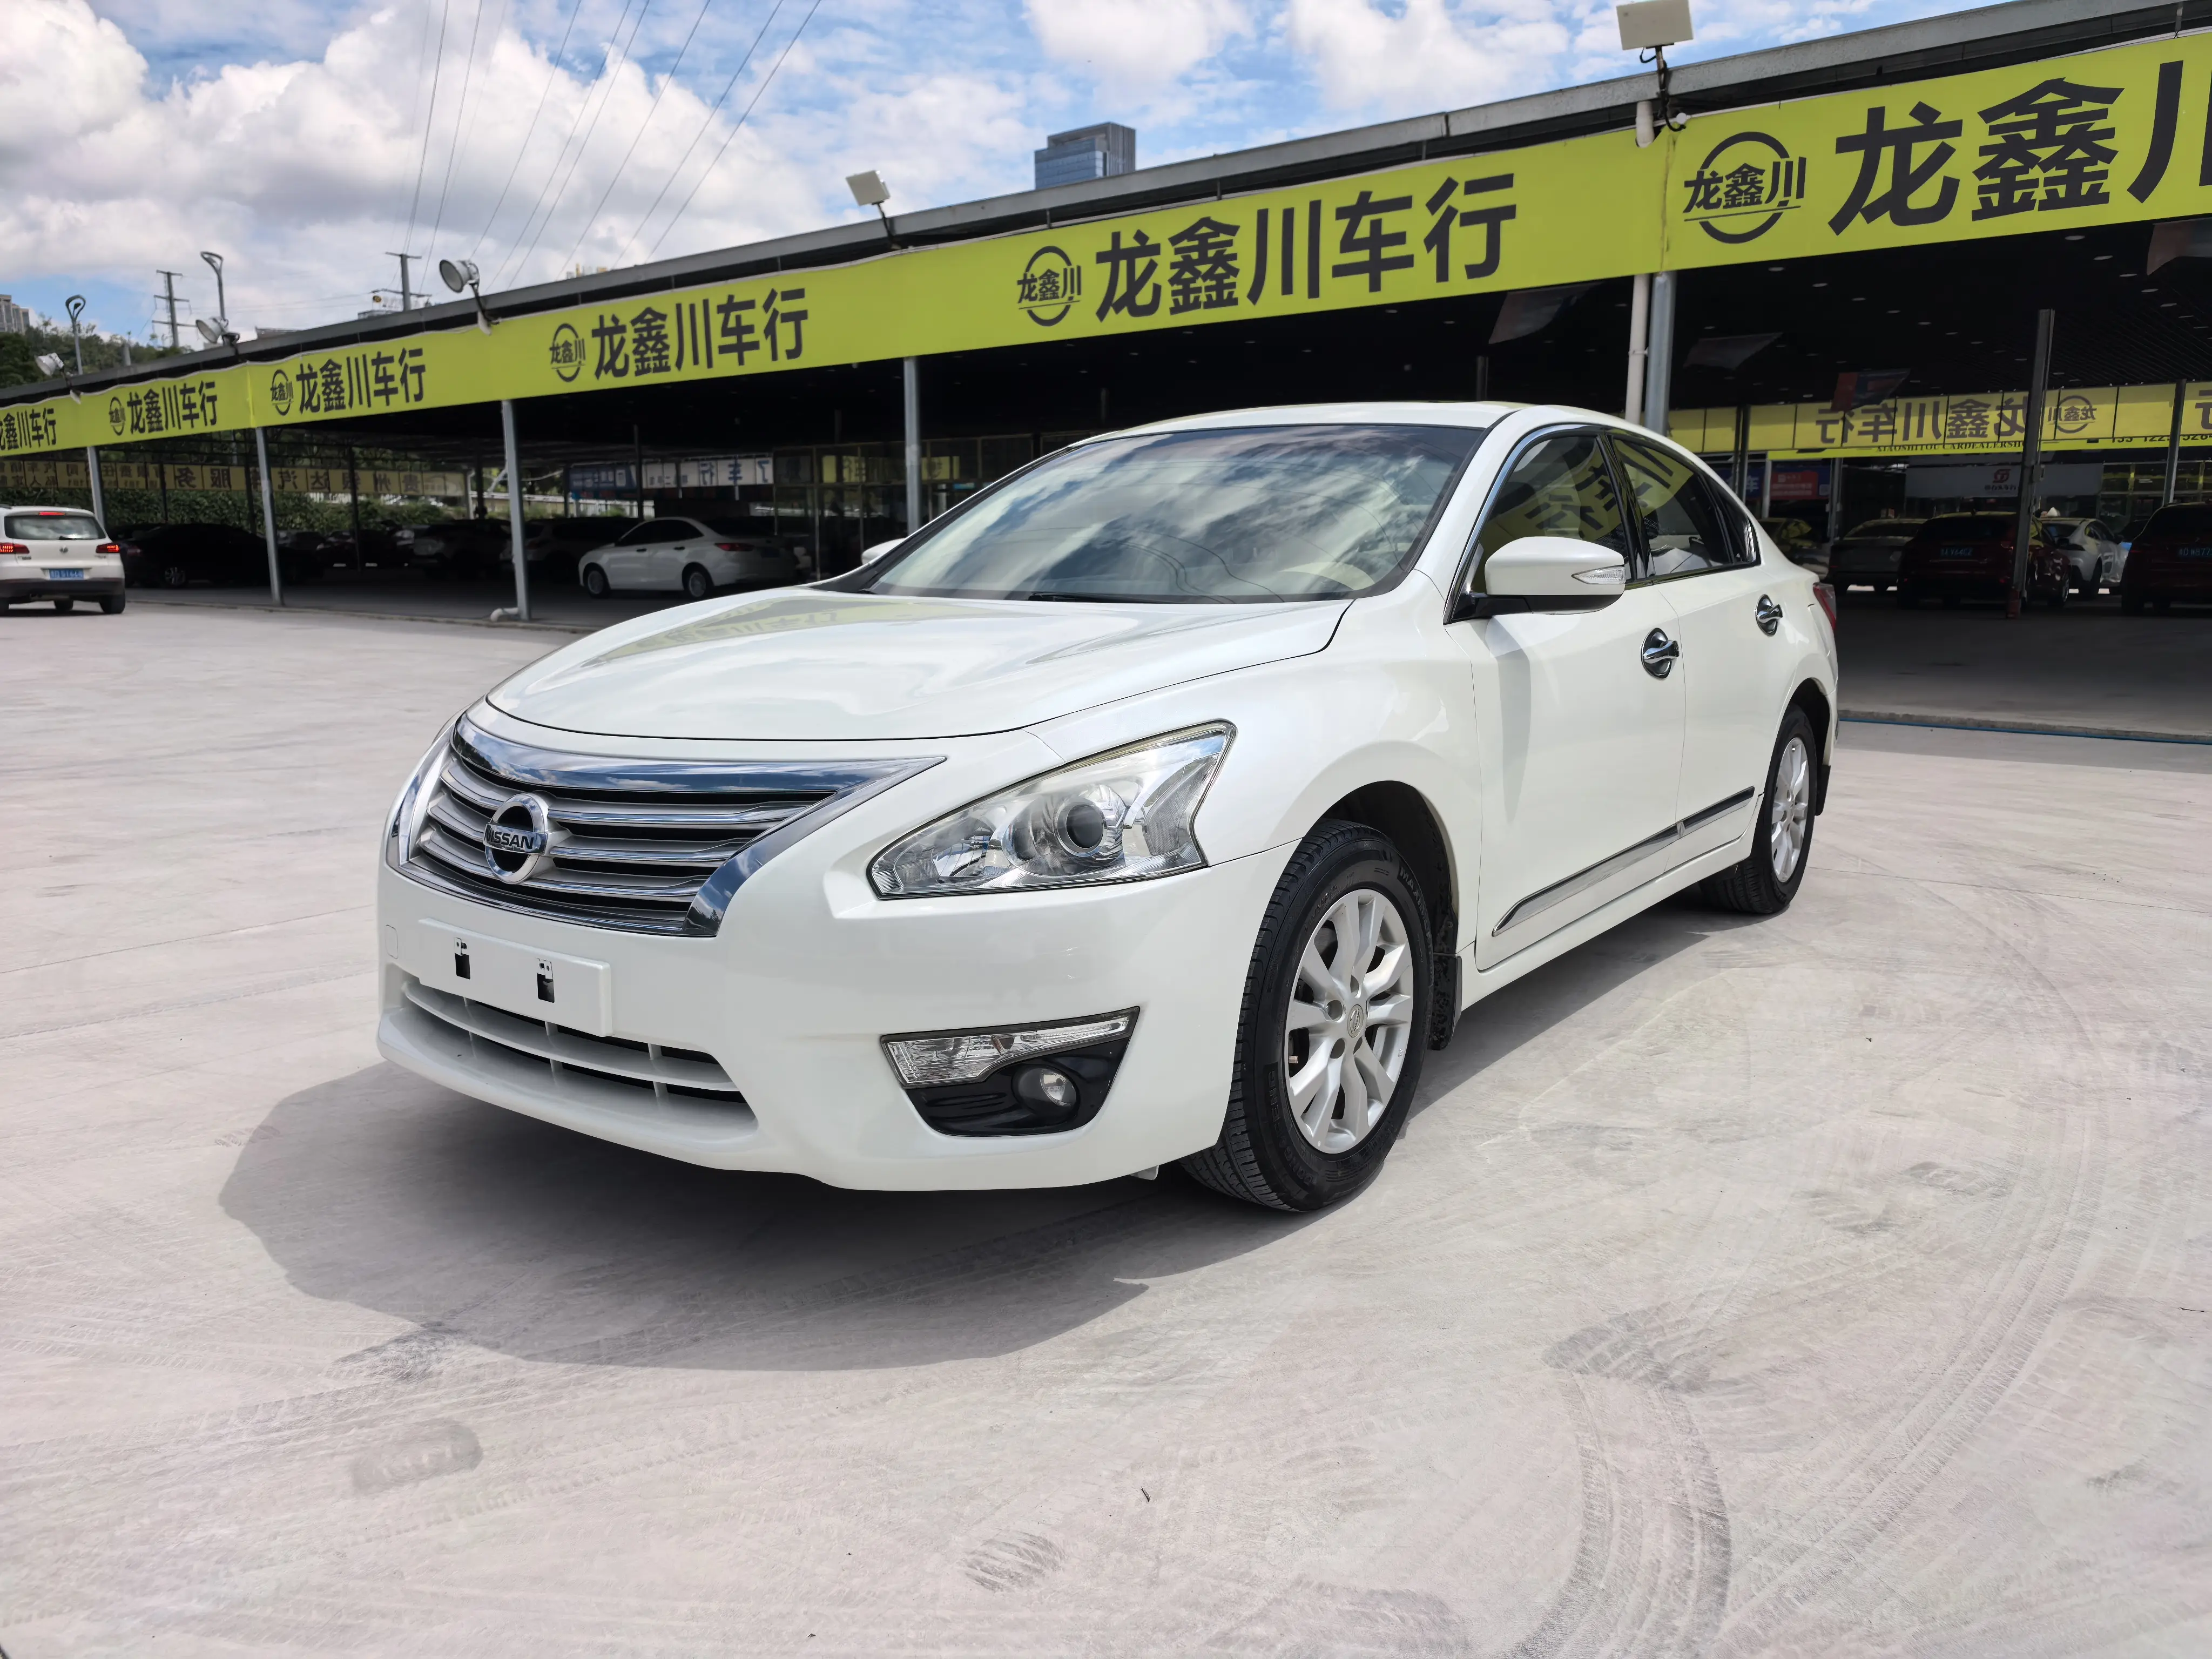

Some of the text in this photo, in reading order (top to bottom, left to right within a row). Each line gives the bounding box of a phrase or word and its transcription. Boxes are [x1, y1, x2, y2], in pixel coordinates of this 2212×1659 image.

[1683, 156, 1806, 213] 龙鑫川
[1017, 173, 1516, 322] 龙鑫川 龙鑫川车行
[549, 288, 810, 380] 龙鑫川 龙鑫川车行
[127, 380, 217, 433] 龙鑫川车行
[296, 347, 425, 413] 龙鑫川车行
[485, 824, 534, 849] NISSAN
